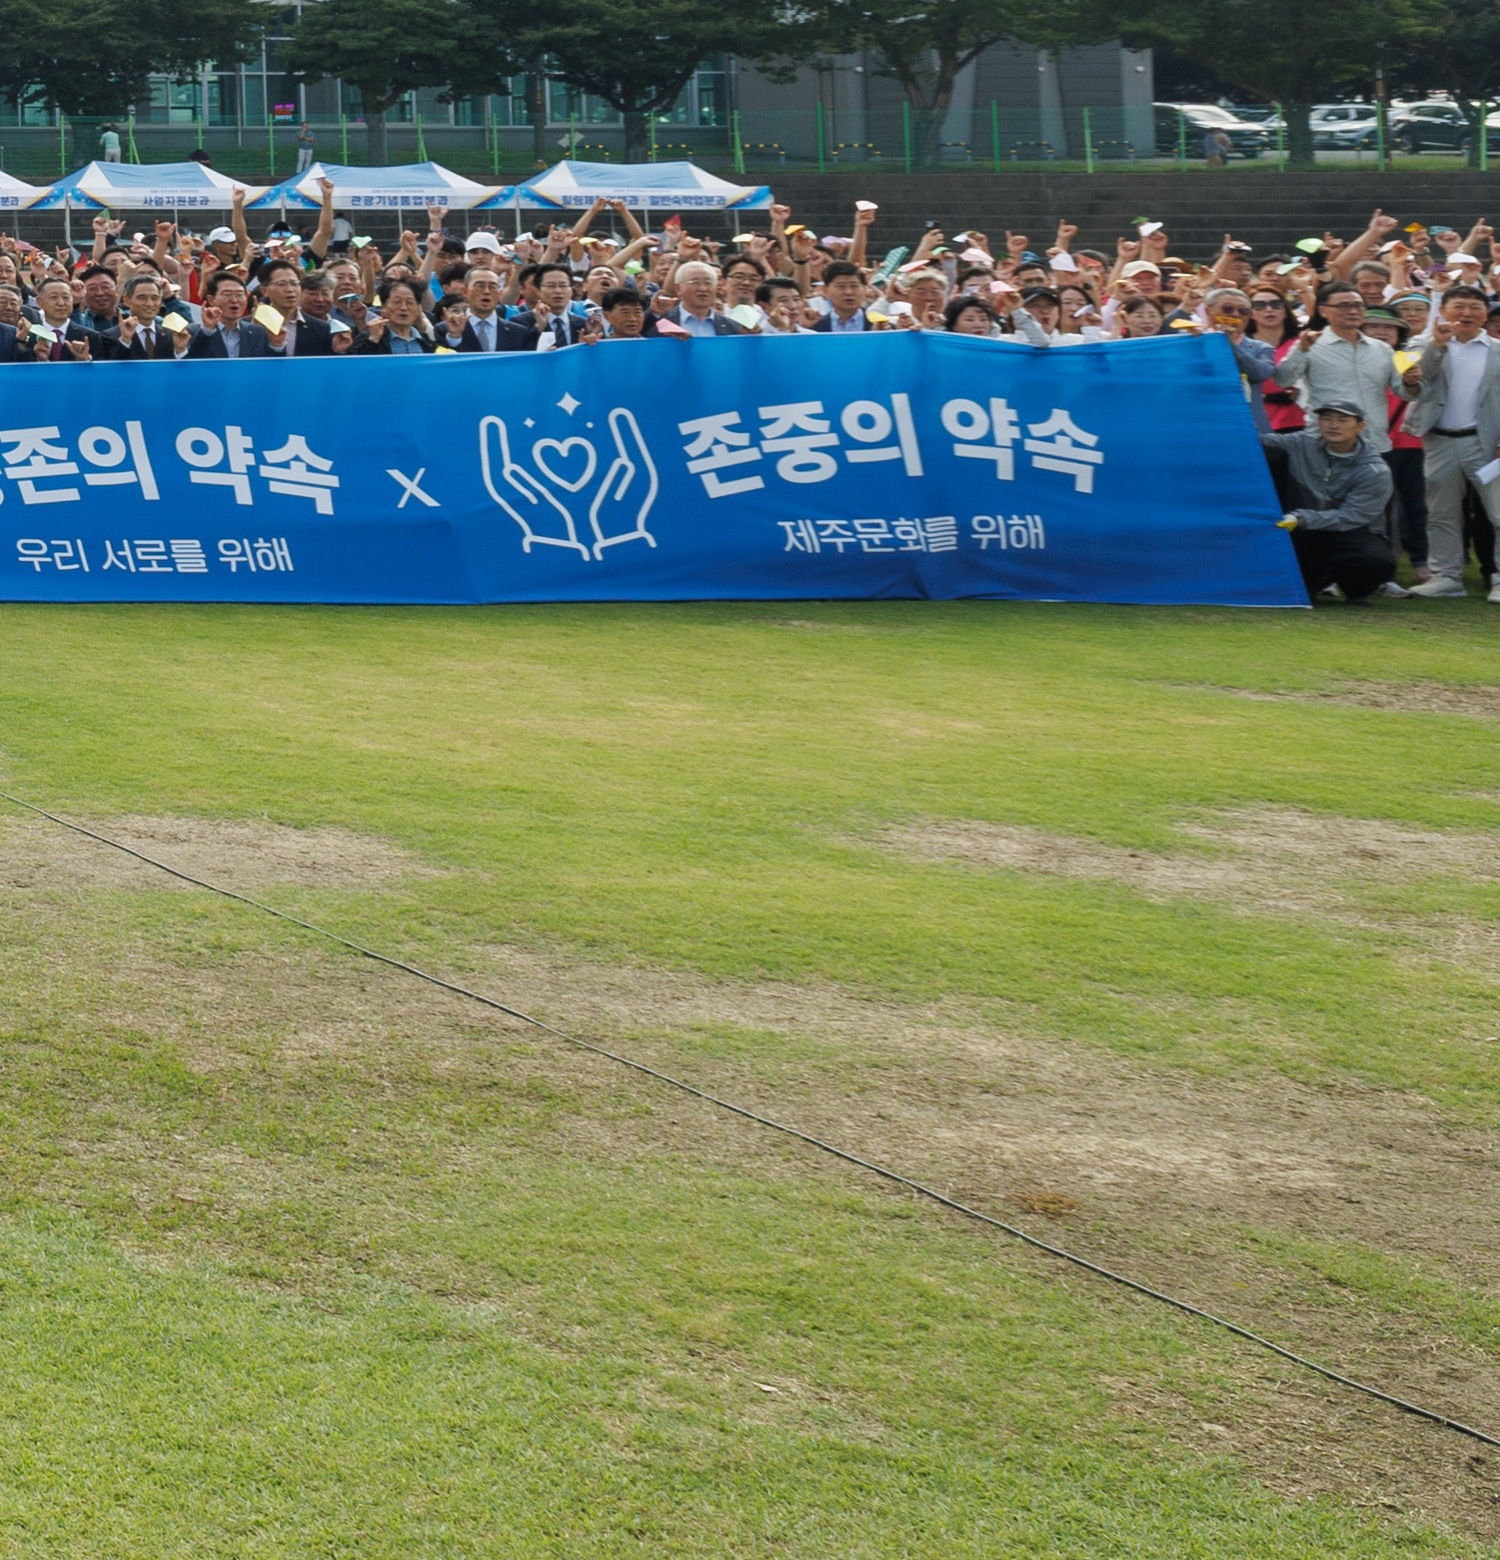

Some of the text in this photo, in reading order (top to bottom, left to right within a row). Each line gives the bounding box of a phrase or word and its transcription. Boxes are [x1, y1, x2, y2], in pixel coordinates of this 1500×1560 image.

[142, 195, 210, 206] 사업지원분과
[679, 394, 1102, 497] 존중의 약속
[177, 426, 338, 514] 약속
[779, 516, 1042, 551] 제주문화를 위해
[17, 538, 293, 572] 우리 서로를 위해
